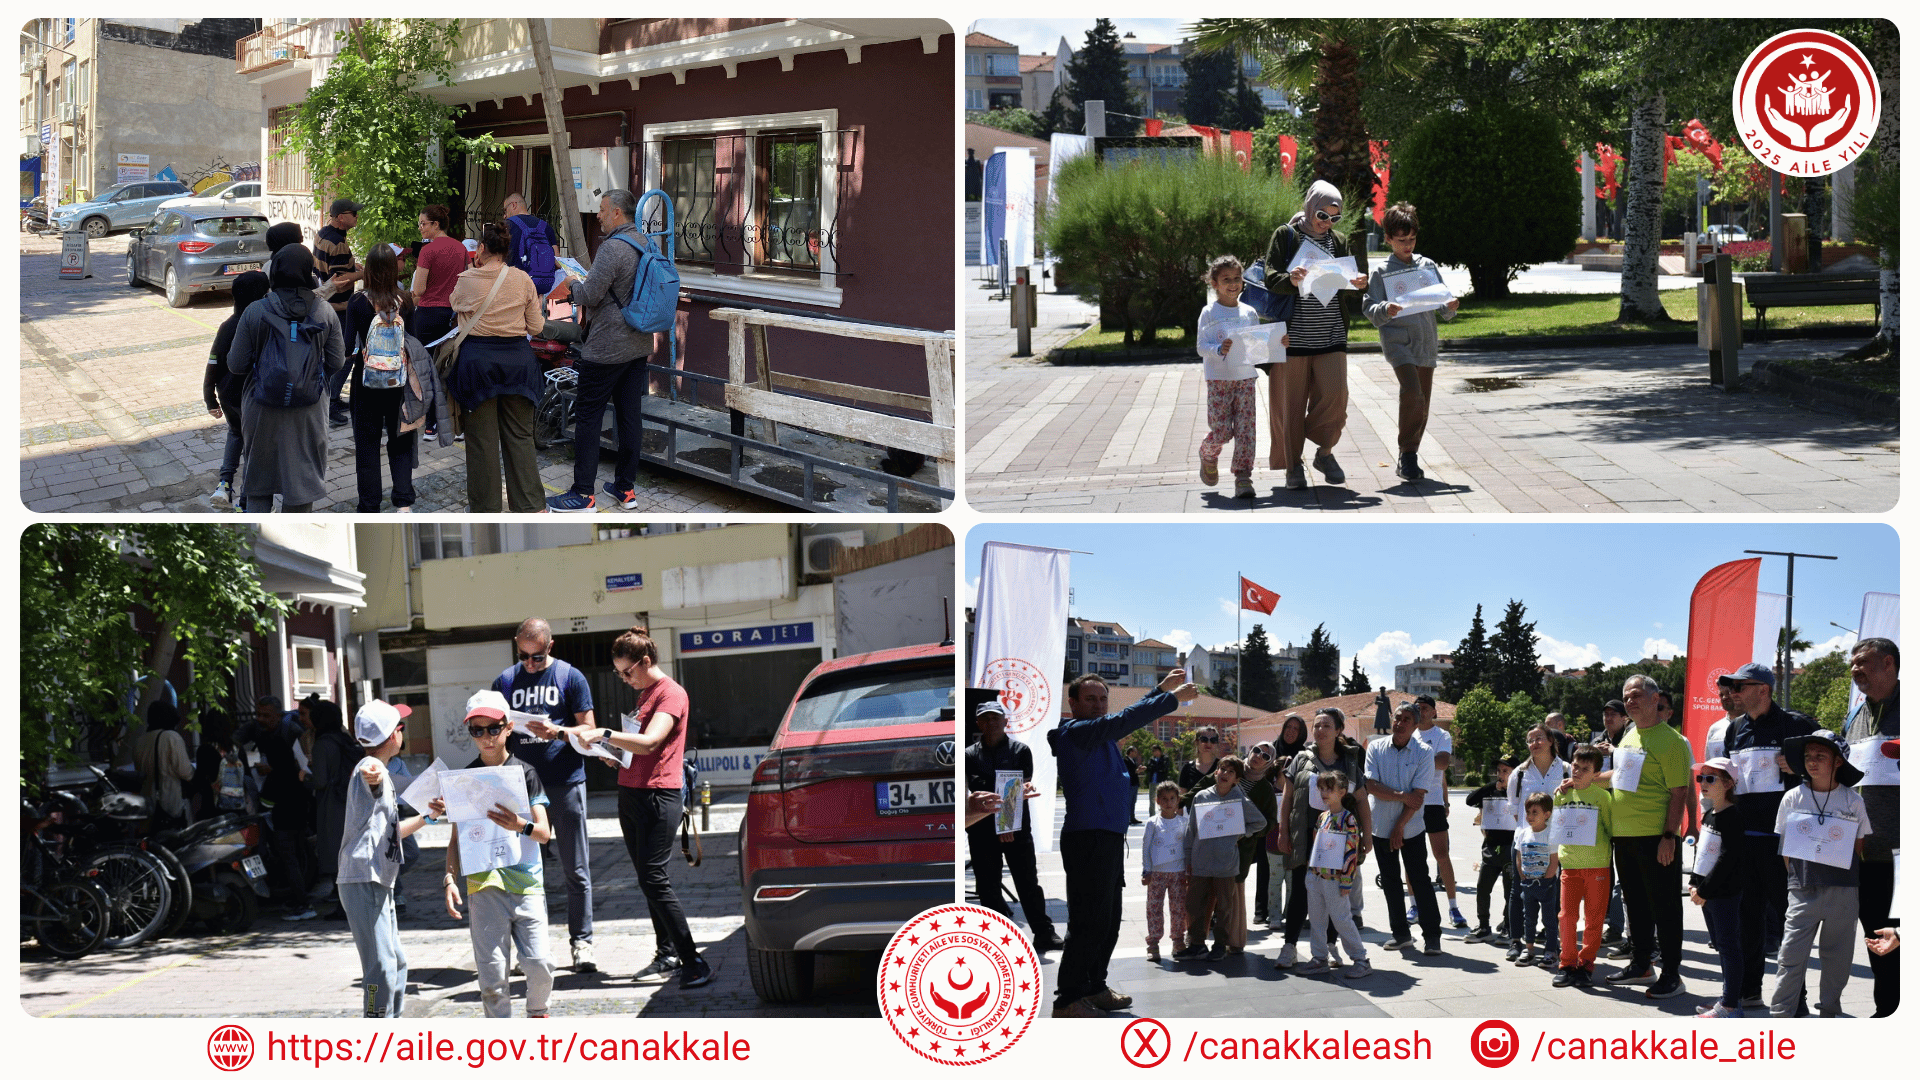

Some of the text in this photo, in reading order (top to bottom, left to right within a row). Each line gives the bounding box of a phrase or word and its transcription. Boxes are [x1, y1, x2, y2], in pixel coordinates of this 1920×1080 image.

[269, 200, 287, 220] DEPO
[512, 685, 559, 709] OHIO
[696, 755, 740, 772] ALLIPOLI
[889, 783, 917, 807] 34
[495, 845, 506, 856] 22
